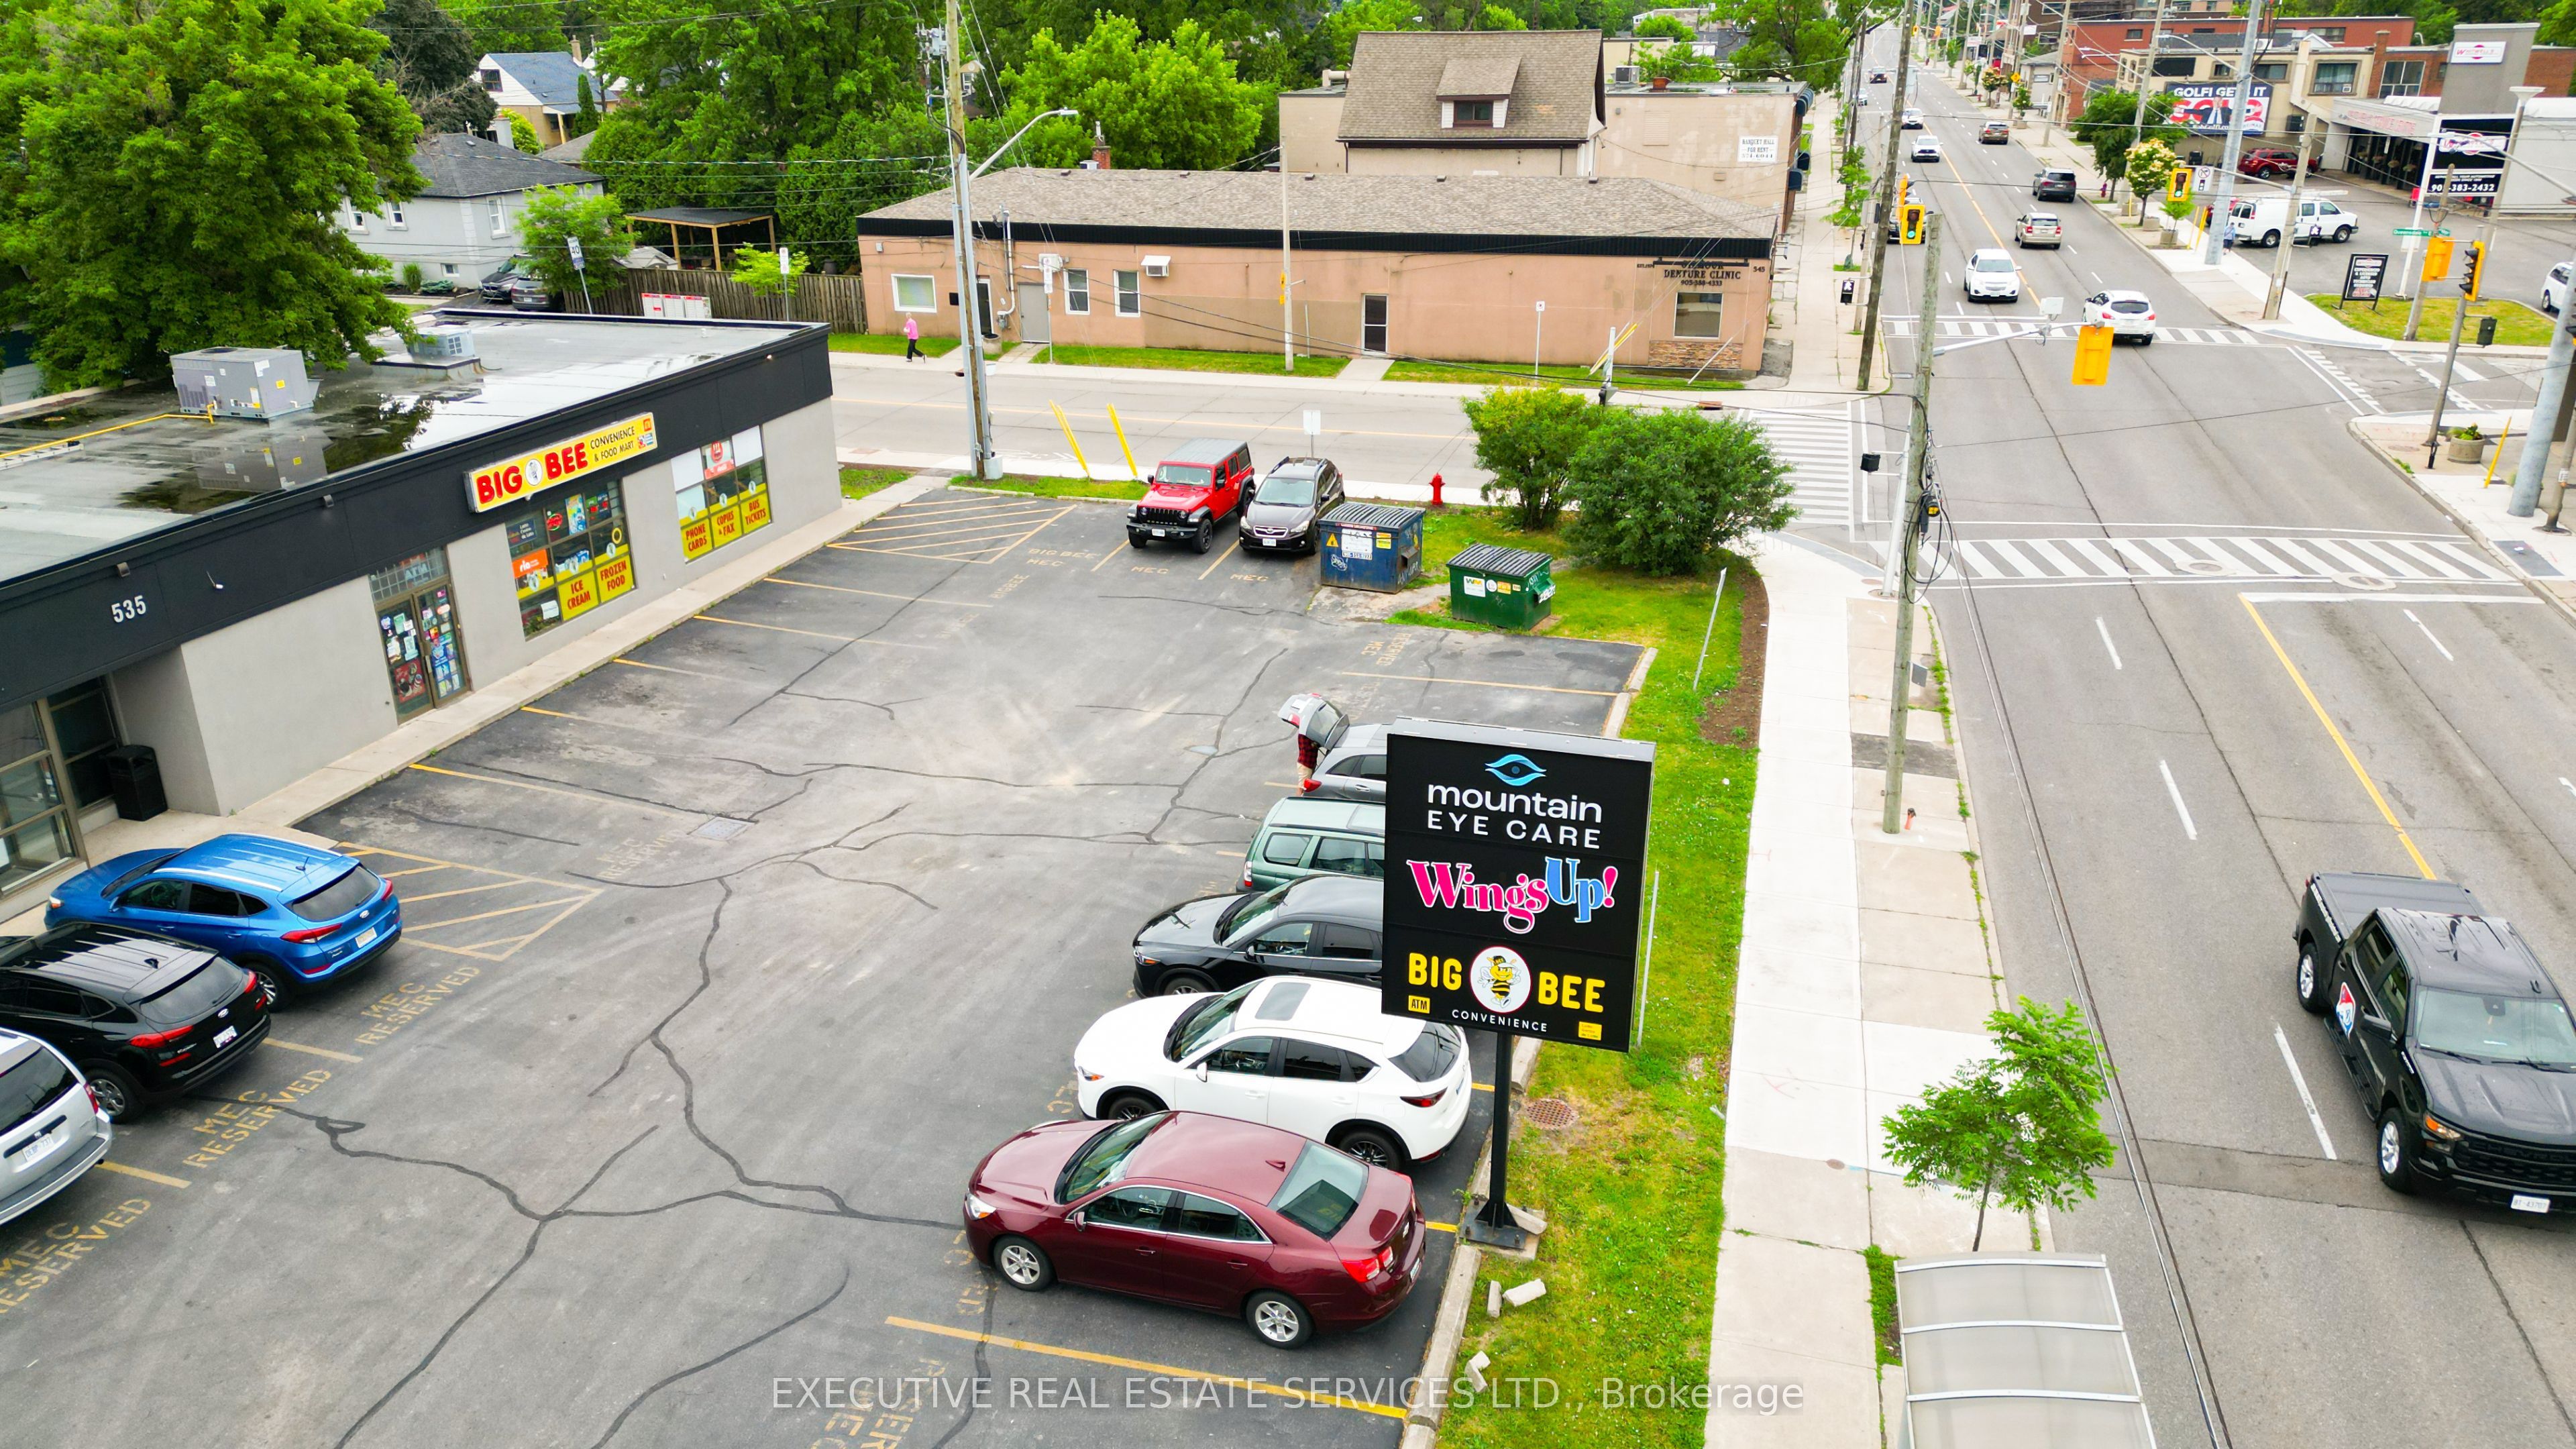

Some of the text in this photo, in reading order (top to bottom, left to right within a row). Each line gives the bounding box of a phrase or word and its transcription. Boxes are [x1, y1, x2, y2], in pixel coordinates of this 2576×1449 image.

[2174, 87, 2213, 97] GOLFI
[2253, 87, 2267, 97] IT
[2432, 184, 2495, 192] 90-383-2432
[571, 246, 580, 254] 40
[1664, 270, 1741, 280] DENTURE CLINIC
[590, 426, 635, 449] CONVENIENCE
[594, 440, 634, 462] & FOOD MART
[477, 442, 588, 504] BIG BEE
[749, 499, 760, 512] BUS
[716, 511, 734, 526] COPIES
[745, 508, 766, 525] TICKETS
[686, 523, 706, 541] PHONE
[723, 523, 735, 536] FAX
[688, 535, 707, 552] CARDS
[600, 560, 627, 581] FROZEN
[571, 580, 584, 594] ICE
[607, 575, 625, 591] FOOD
[111, 595, 147, 623] 535
[567, 590, 591, 610] CREAM
[1428, 784, 1602, 823] mountain
[1428, 810, 1601, 849] EYE CARE
[1409, 953, 1605, 1013] BIG BEE
[354, 966, 481, 1045] RESERVED
[361, 982, 425, 1018] MEC
[1411, 999, 1428, 1010] ATM
[1452, 1009, 1548, 1032] CONVENIENCE
[182, 1069, 331, 1168] RESERVED
[193, 1090, 268, 1134] MEC
[0, 1199, 151, 1313] ESERVED
